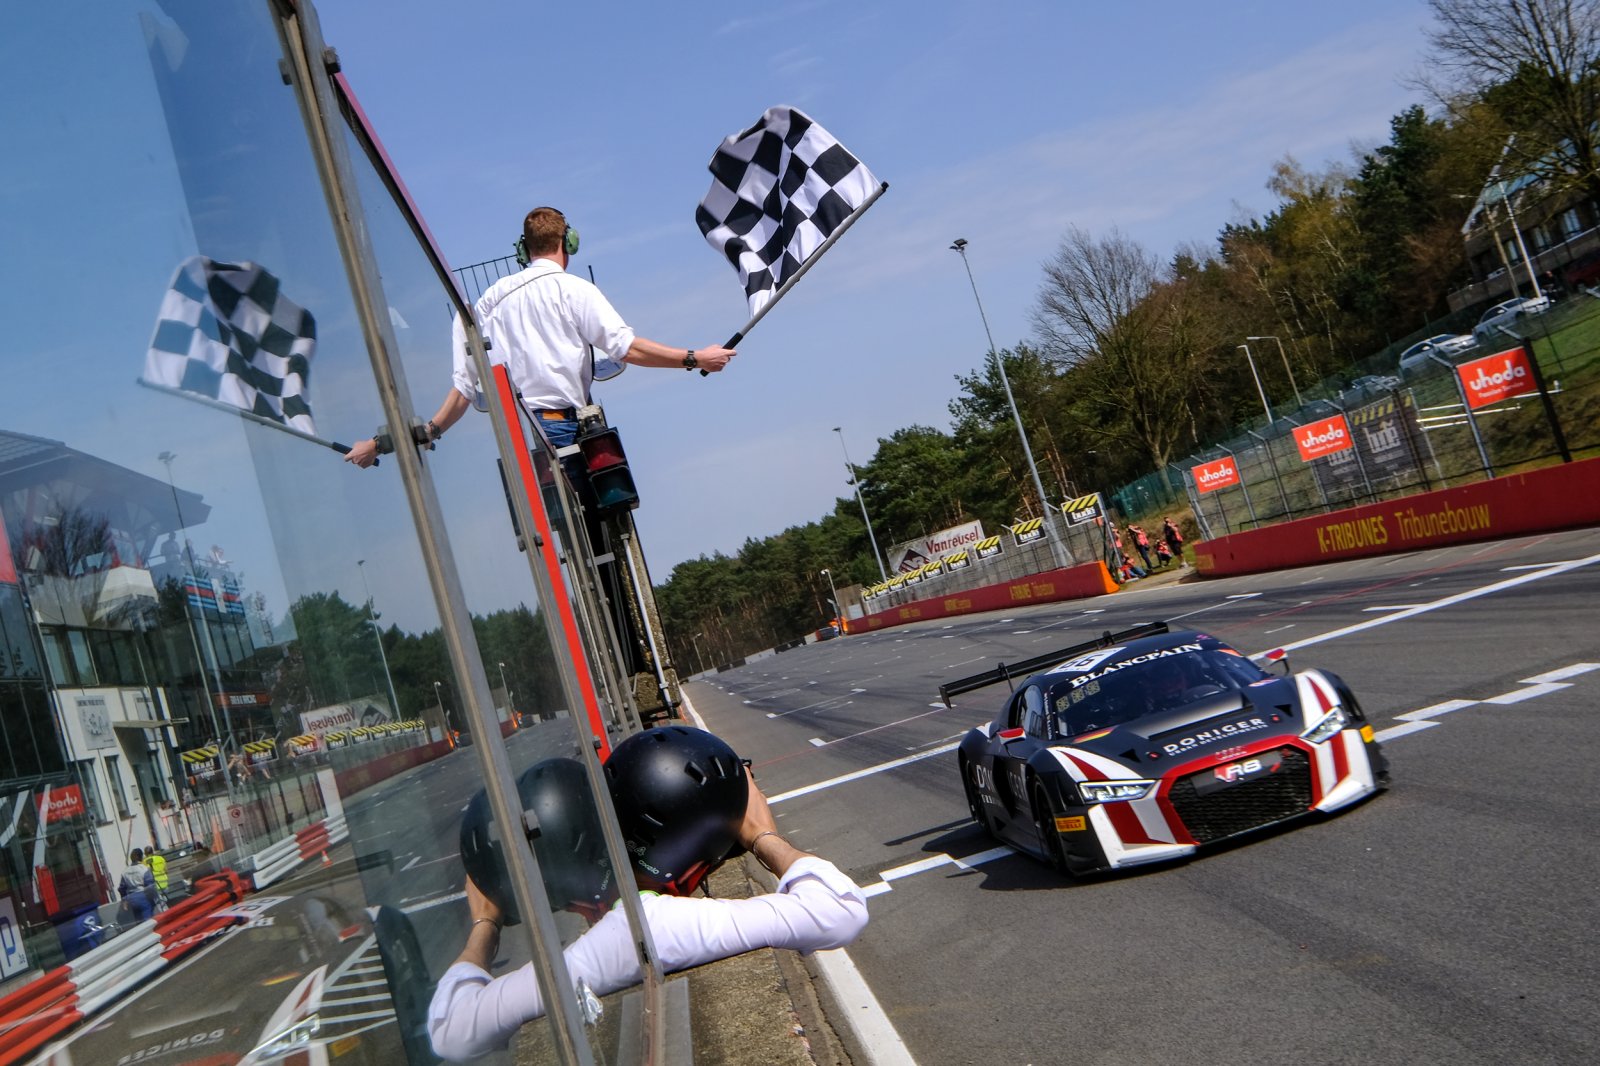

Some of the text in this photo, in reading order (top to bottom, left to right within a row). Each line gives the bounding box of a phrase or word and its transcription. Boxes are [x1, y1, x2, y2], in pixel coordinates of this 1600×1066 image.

[1469, 359, 1526, 391] uhoda
[1301, 424, 1344, 448] uhoda
[1199, 463, 1234, 483] uhoda
[926, 525, 980, 555] Vanreusel
[1316, 501, 1491, 553] K-TRIBUNES Tribunebouw
[1069, 643, 1203, 689] BLANCPAIN
[1163, 718, 1265, 753] DONIGER
[1225, 759, 1262, 780] R8
